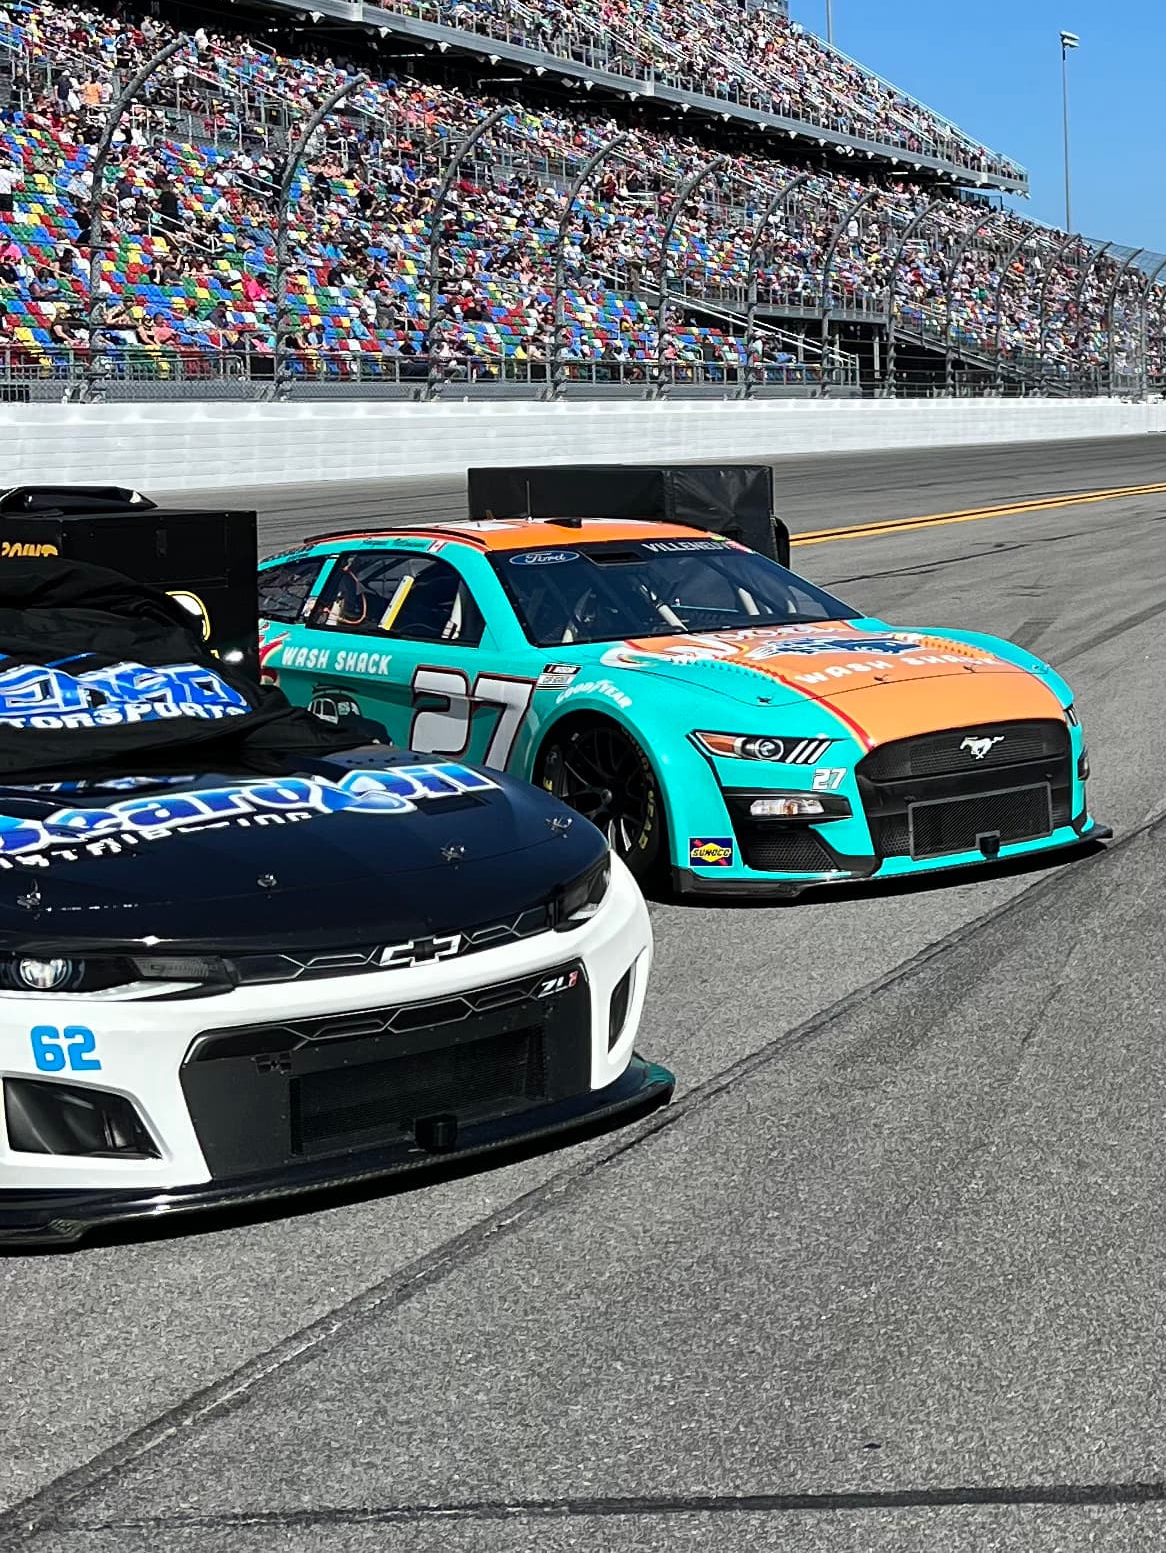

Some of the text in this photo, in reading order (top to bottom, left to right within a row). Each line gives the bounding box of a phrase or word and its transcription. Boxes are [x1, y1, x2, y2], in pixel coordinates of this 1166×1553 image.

[525, 552, 567, 563] Ford
[281, 647, 393, 676] WASH SHACK
[794, 654, 1003, 685] WASH SHACK
[410, 663, 538, 773] 27
[812, 767, 848, 790] 27
[692, 848, 731, 857] SUNOCO
[538, 970, 579, 998] ZL1
[31, 1025, 102, 1071] 62
